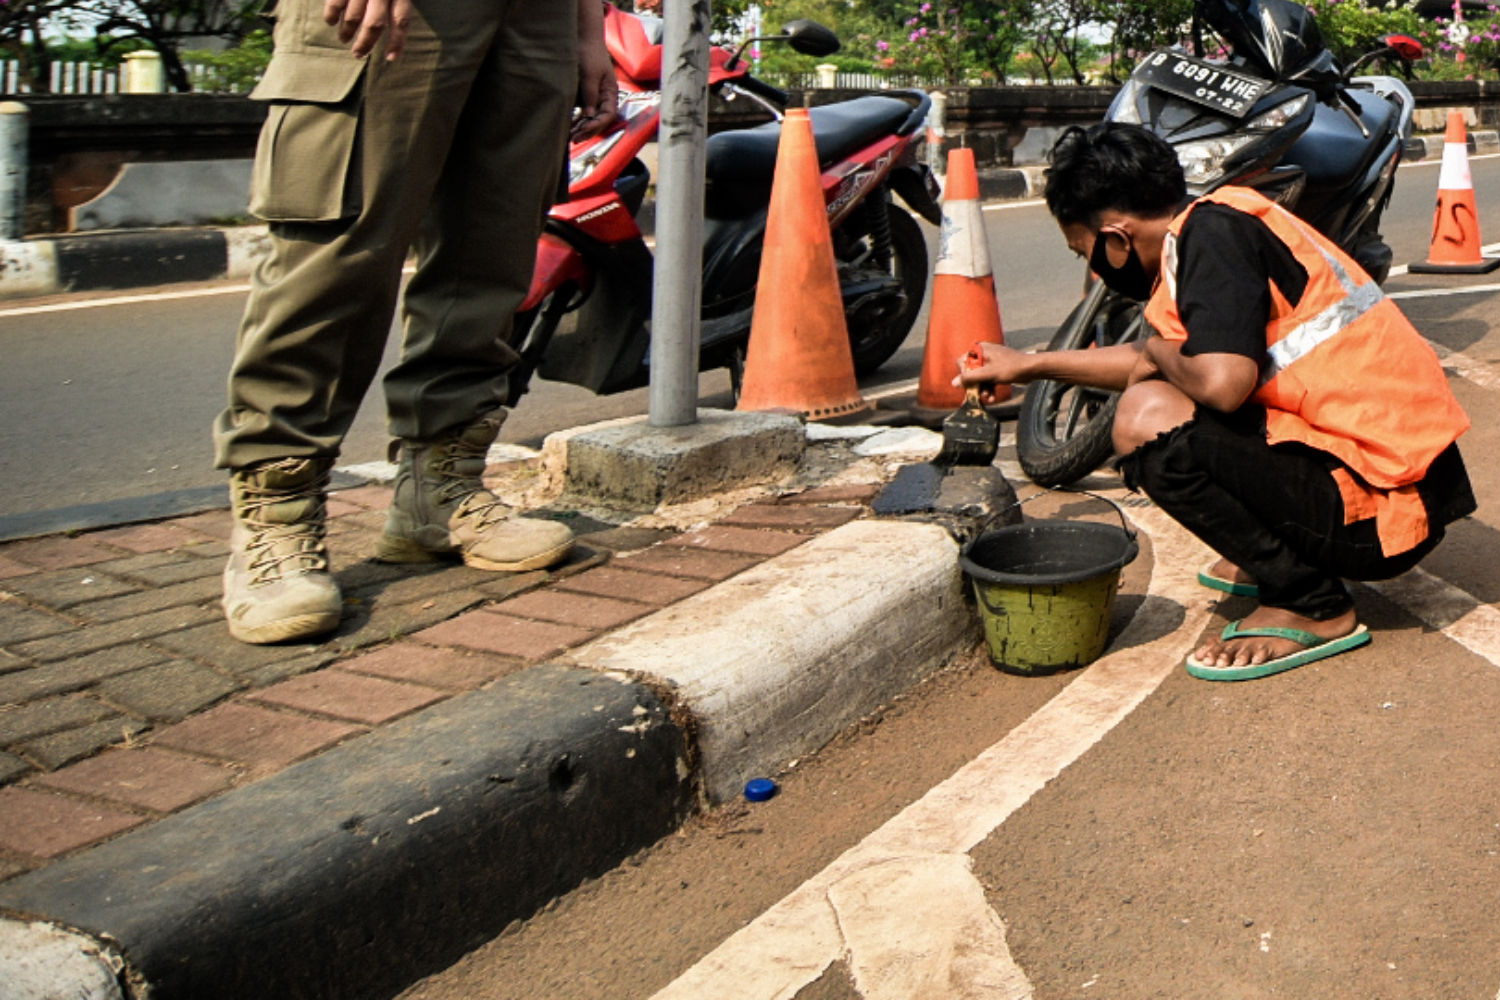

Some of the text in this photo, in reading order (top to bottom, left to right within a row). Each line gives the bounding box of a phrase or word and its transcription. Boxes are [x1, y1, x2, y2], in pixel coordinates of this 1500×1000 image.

[1152, 53, 1167, 66] B
[1173, 61, 1219, 85] 6091
[576, 202, 619, 223] HONDA
